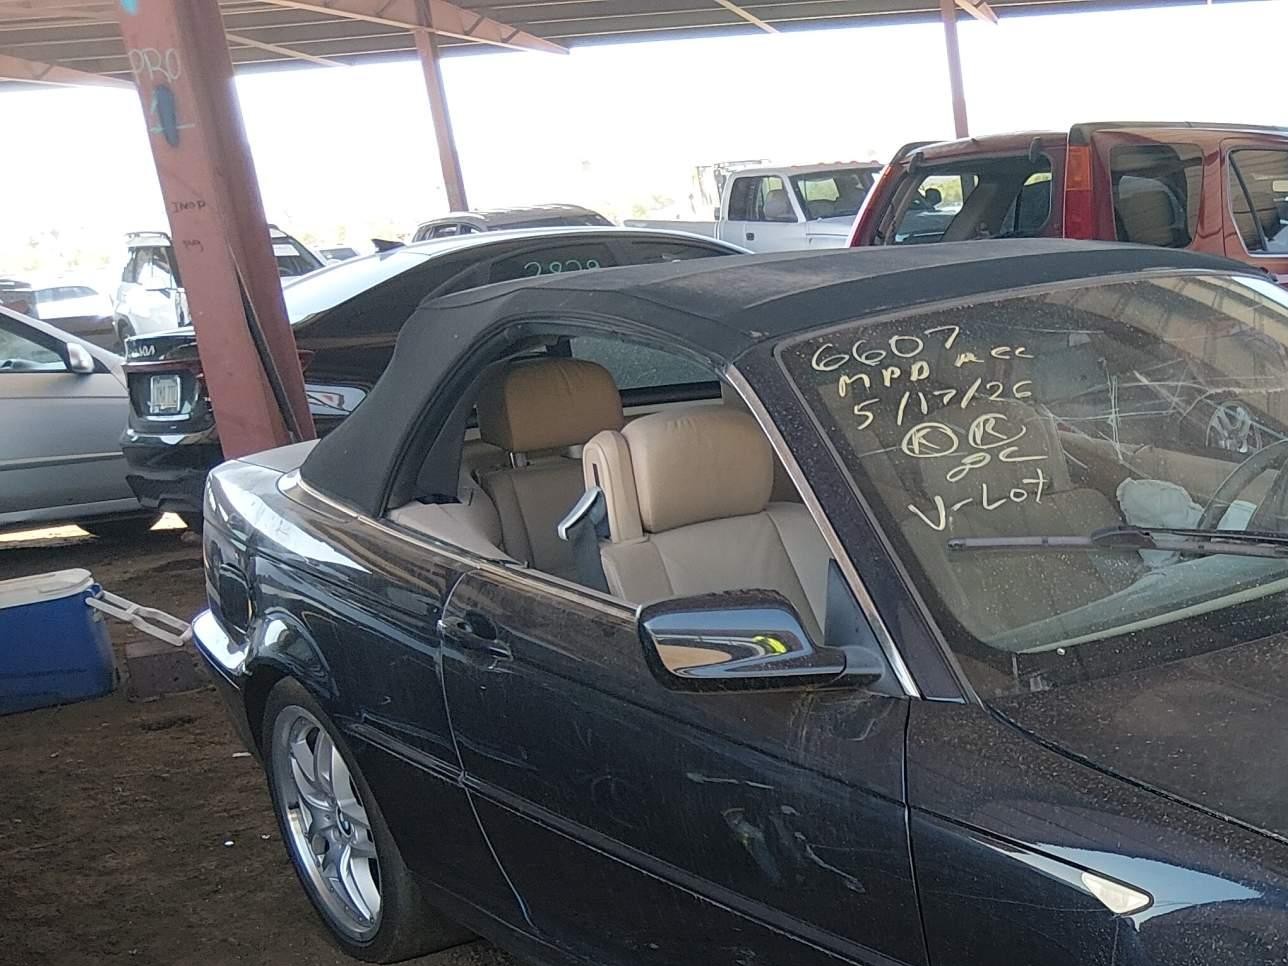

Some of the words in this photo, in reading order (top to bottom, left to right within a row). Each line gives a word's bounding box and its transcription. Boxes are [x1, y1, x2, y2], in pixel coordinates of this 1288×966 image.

[127, 47, 181, 85] PRO
[811, 325, 960, 372] 6607
[838, 361, 930, 397] MPD
